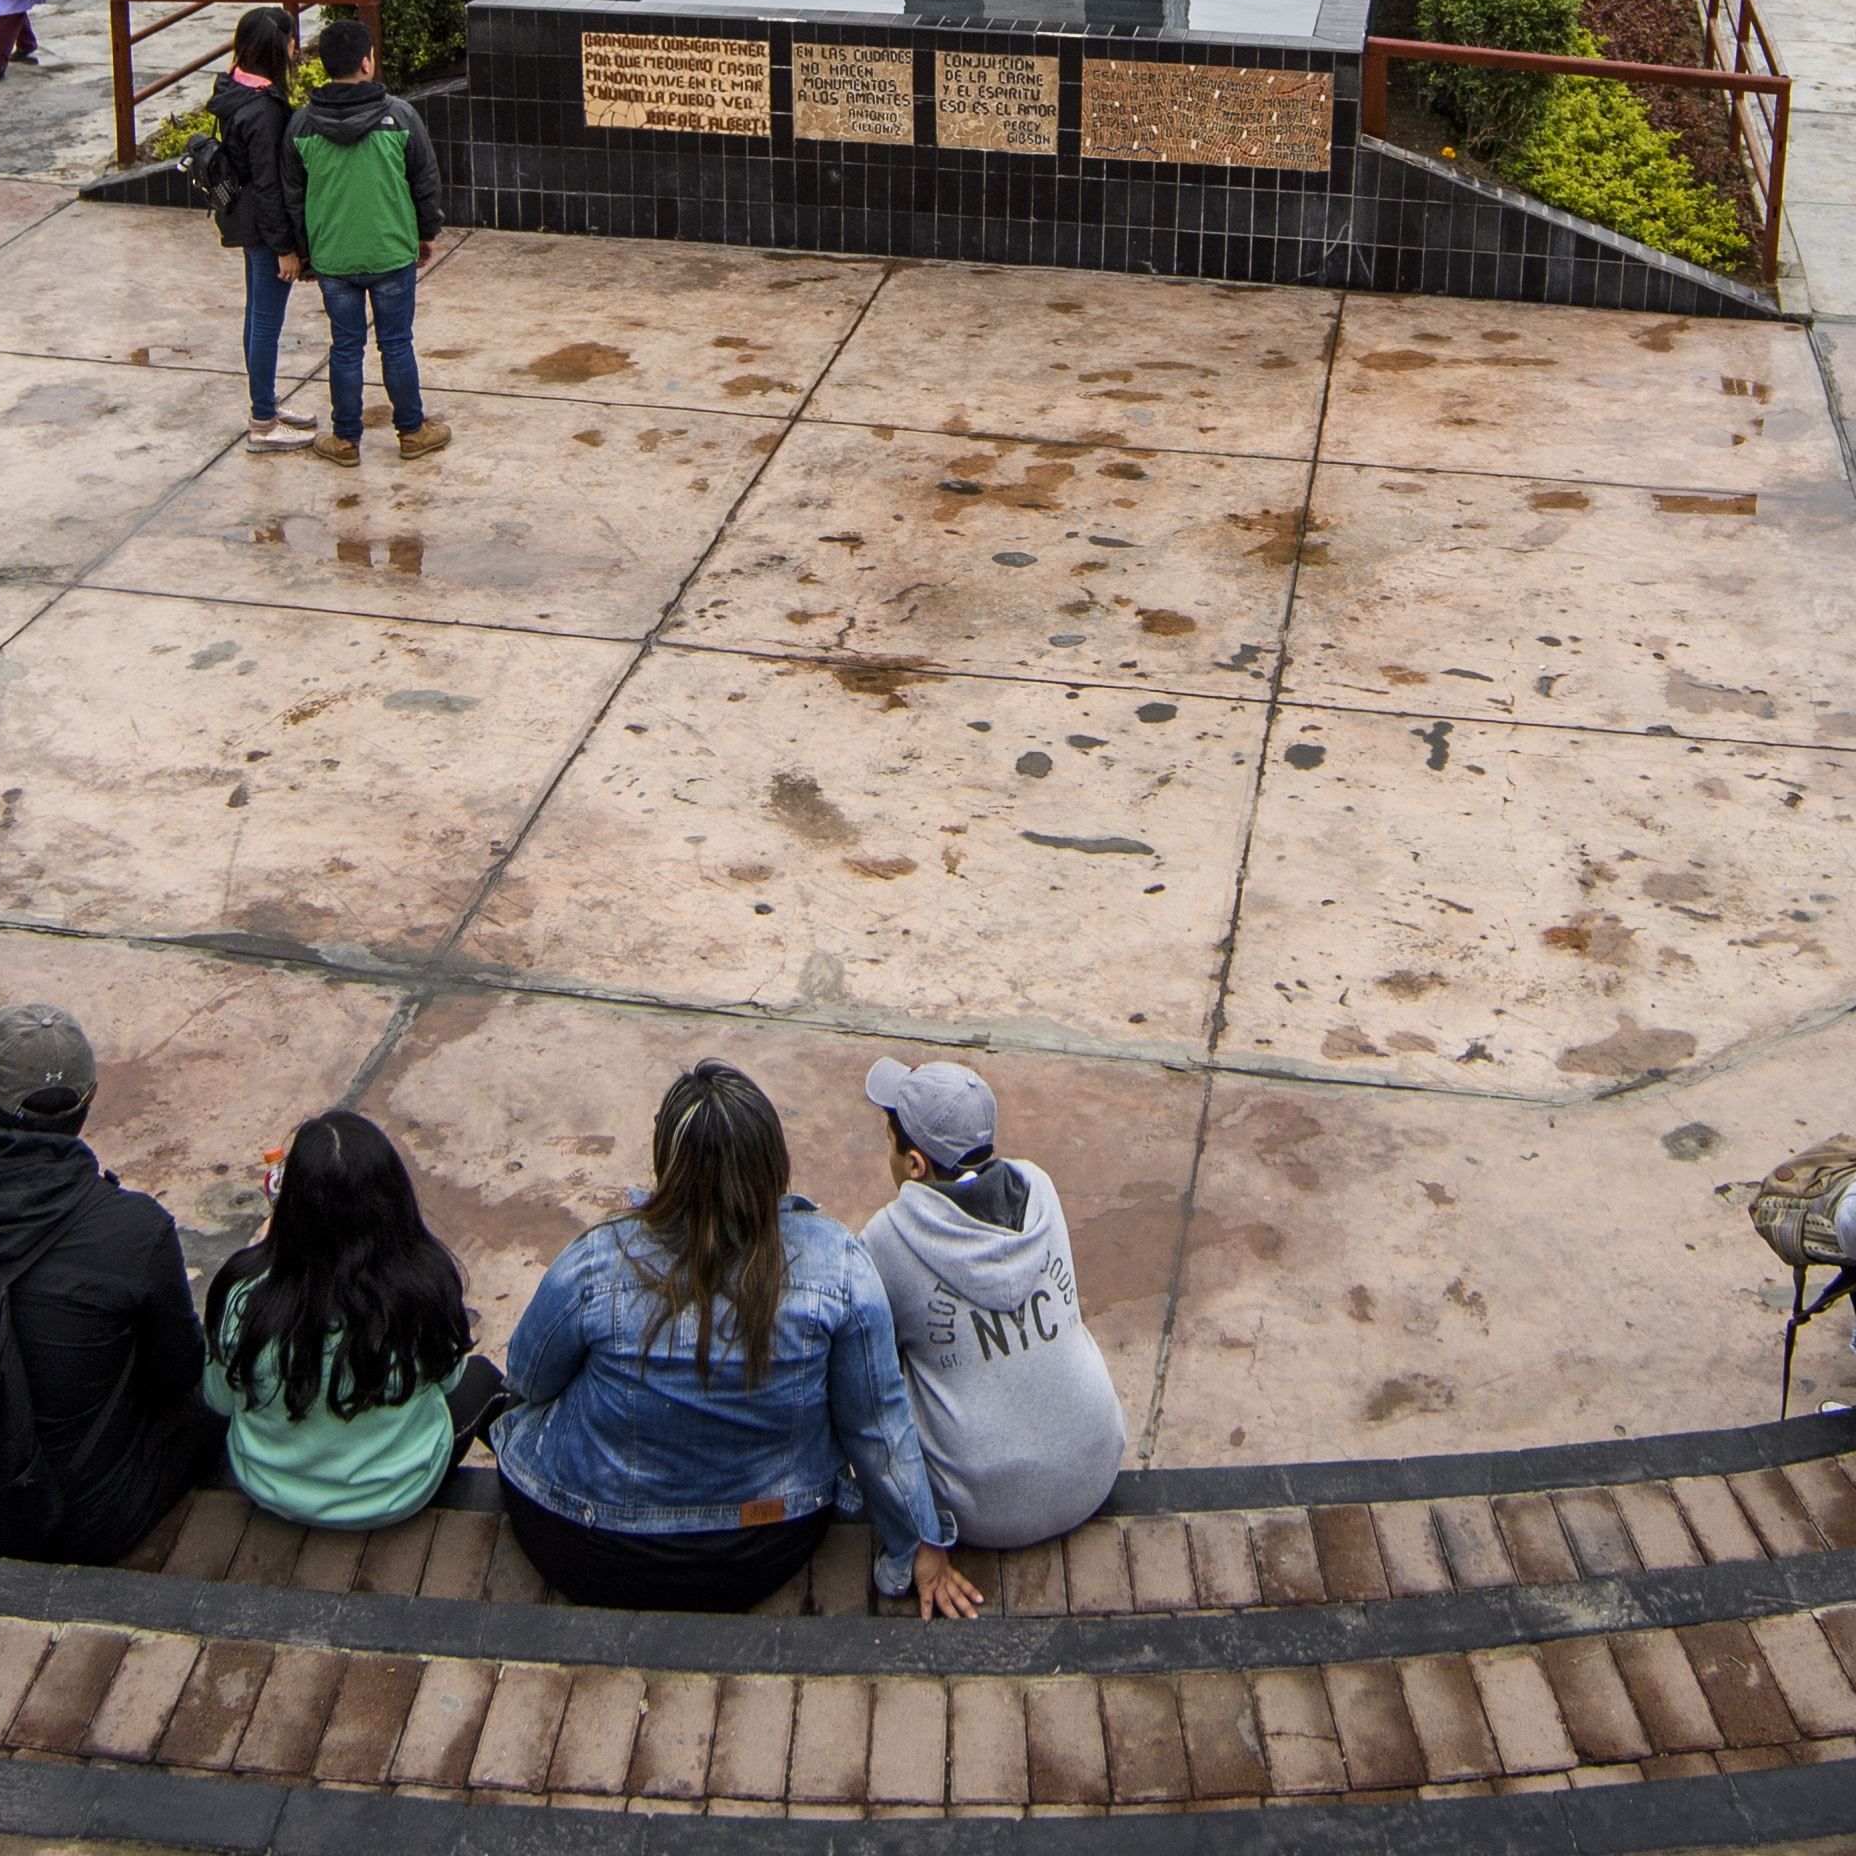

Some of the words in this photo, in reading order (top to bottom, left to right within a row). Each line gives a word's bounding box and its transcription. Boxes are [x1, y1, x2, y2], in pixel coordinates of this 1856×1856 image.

[722, 40, 766, 58] TENER
[796, 45, 814, 58] EN
[821, 47, 847, 61] LAS
[853, 49, 912, 64] CIUDADES
[584, 51, 612, 67] POR
[614, 55, 641, 69] QUE
[718, 61, 764, 78] CASAR
[801, 62, 820, 75] NO
[829, 64, 874, 78] HACEN
[586, 68, 601, 82] MI
[650, 74, 684, 88] VIVE
[688, 76, 706, 90] EN
[710, 78, 727, 92] EL
[731, 80, 764, 93] MAR
[803, 77, 897, 93] MONUMENTOS
[945, 70, 962, 83] DE
[968, 70, 987, 83] LA
[998, 71, 1044, 87] CARNE
[798, 89, 807, 102] A
[812, 91, 839, 106] LOS
[846, 92, 911, 107] AMANTES
[942, 84, 950, 96] Y
[957, 85, 972, 98] EL
[978, 86, 1041, 101] ESPIRITU
[721, 96, 754, 111] VER
[939, 99, 967, 114] ESO
[972, 101, 990, 116] ES
[995, 102, 1012, 116] EL
[1017, 104, 1057, 118] AMOR
[646, 111, 706, 130] RAFAEL
[848, 108, 897, 123] ANTONIO
[1004, 120, 1042, 132] PERCY
[1006, 132, 1051, 145] GIBSON
[969, 1289, 1059, 1363] NYC
